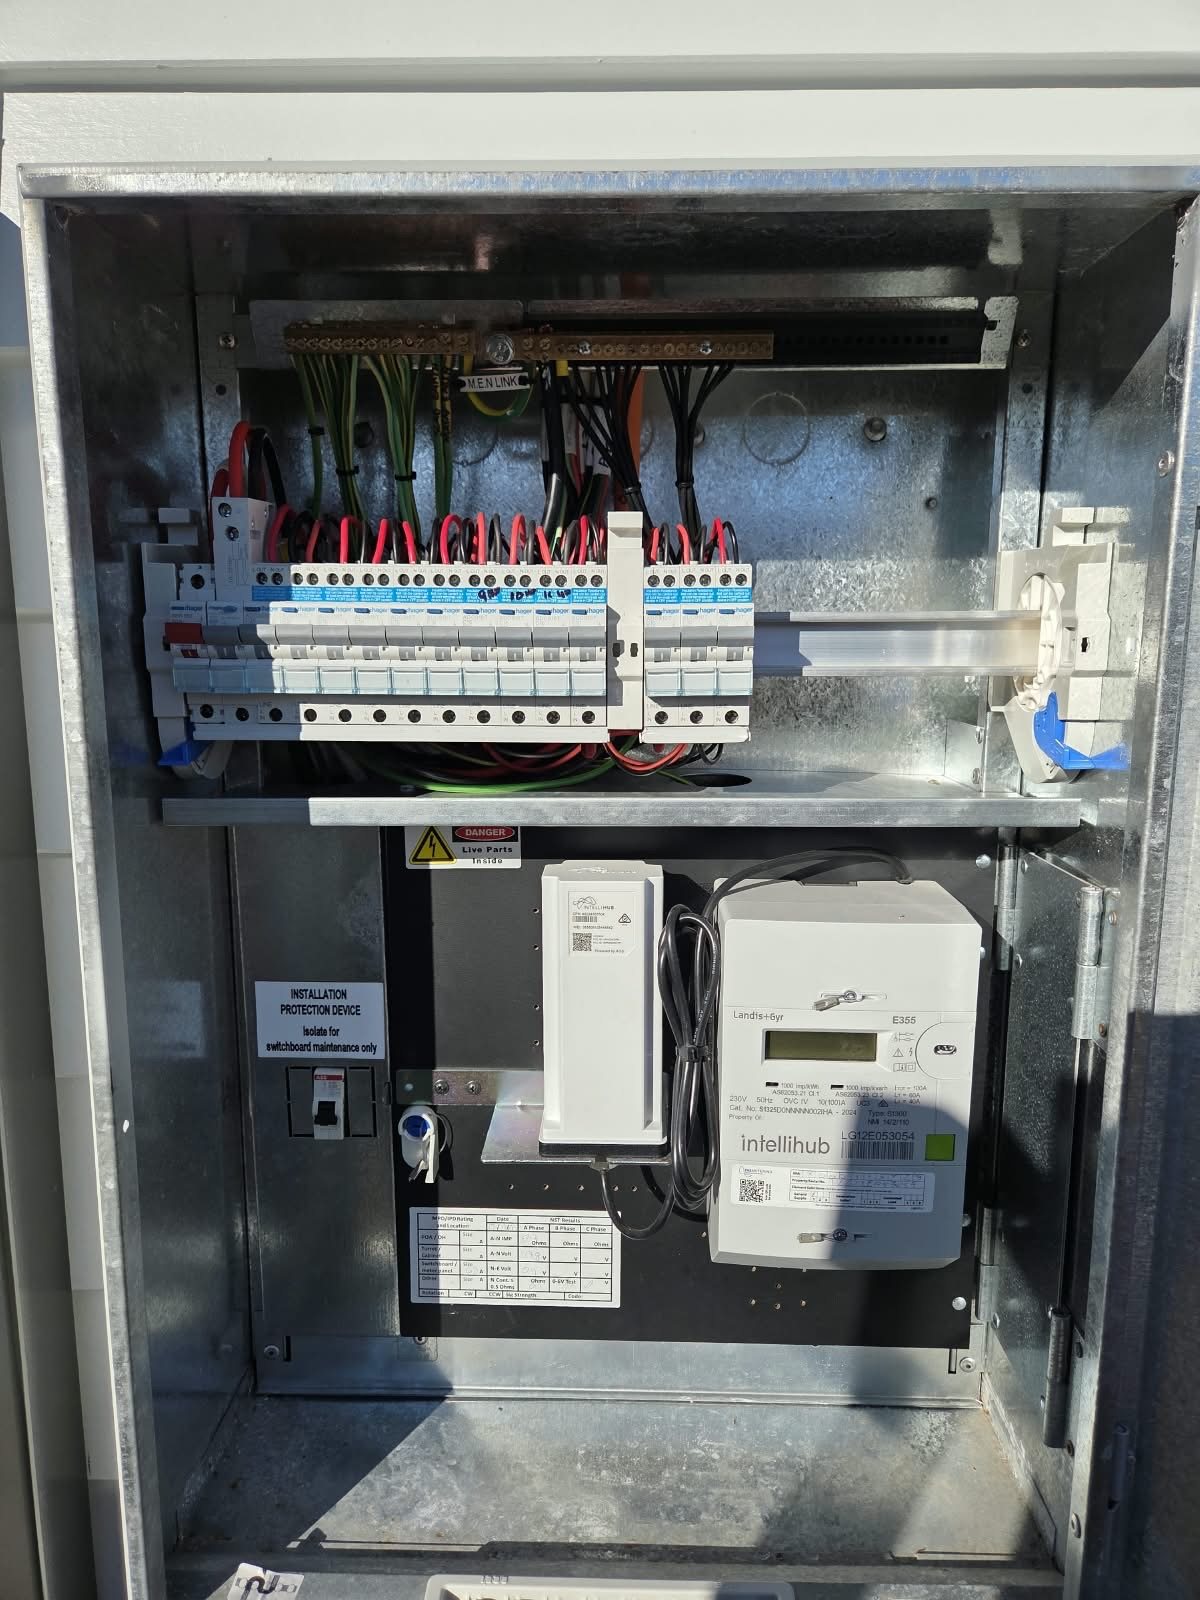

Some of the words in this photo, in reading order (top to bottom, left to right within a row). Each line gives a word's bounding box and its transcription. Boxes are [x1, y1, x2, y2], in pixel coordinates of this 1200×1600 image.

[496, 376, 518, 388] LINK
[291, 989, 347, 1000] INSTALLATION
[280, 1004, 330, 1015] PROTECTION
[332, 1005, 361, 1016] DEVICE
[733, 1010, 784, 1022] Landis+Gyr
[892, 1016, 916, 1024] E355
[303, 1026, 327, 1036] Isolate
[329, 1026, 340, 1036] for
[266, 1041, 312, 1052] switchboard
[313, 1042, 360, 1053] maintenance
[361, 1042, 377, 1055] only
[841, 1130, 915, 1140] LG12E053054
[741, 1133, 830, 1154] intellihub
